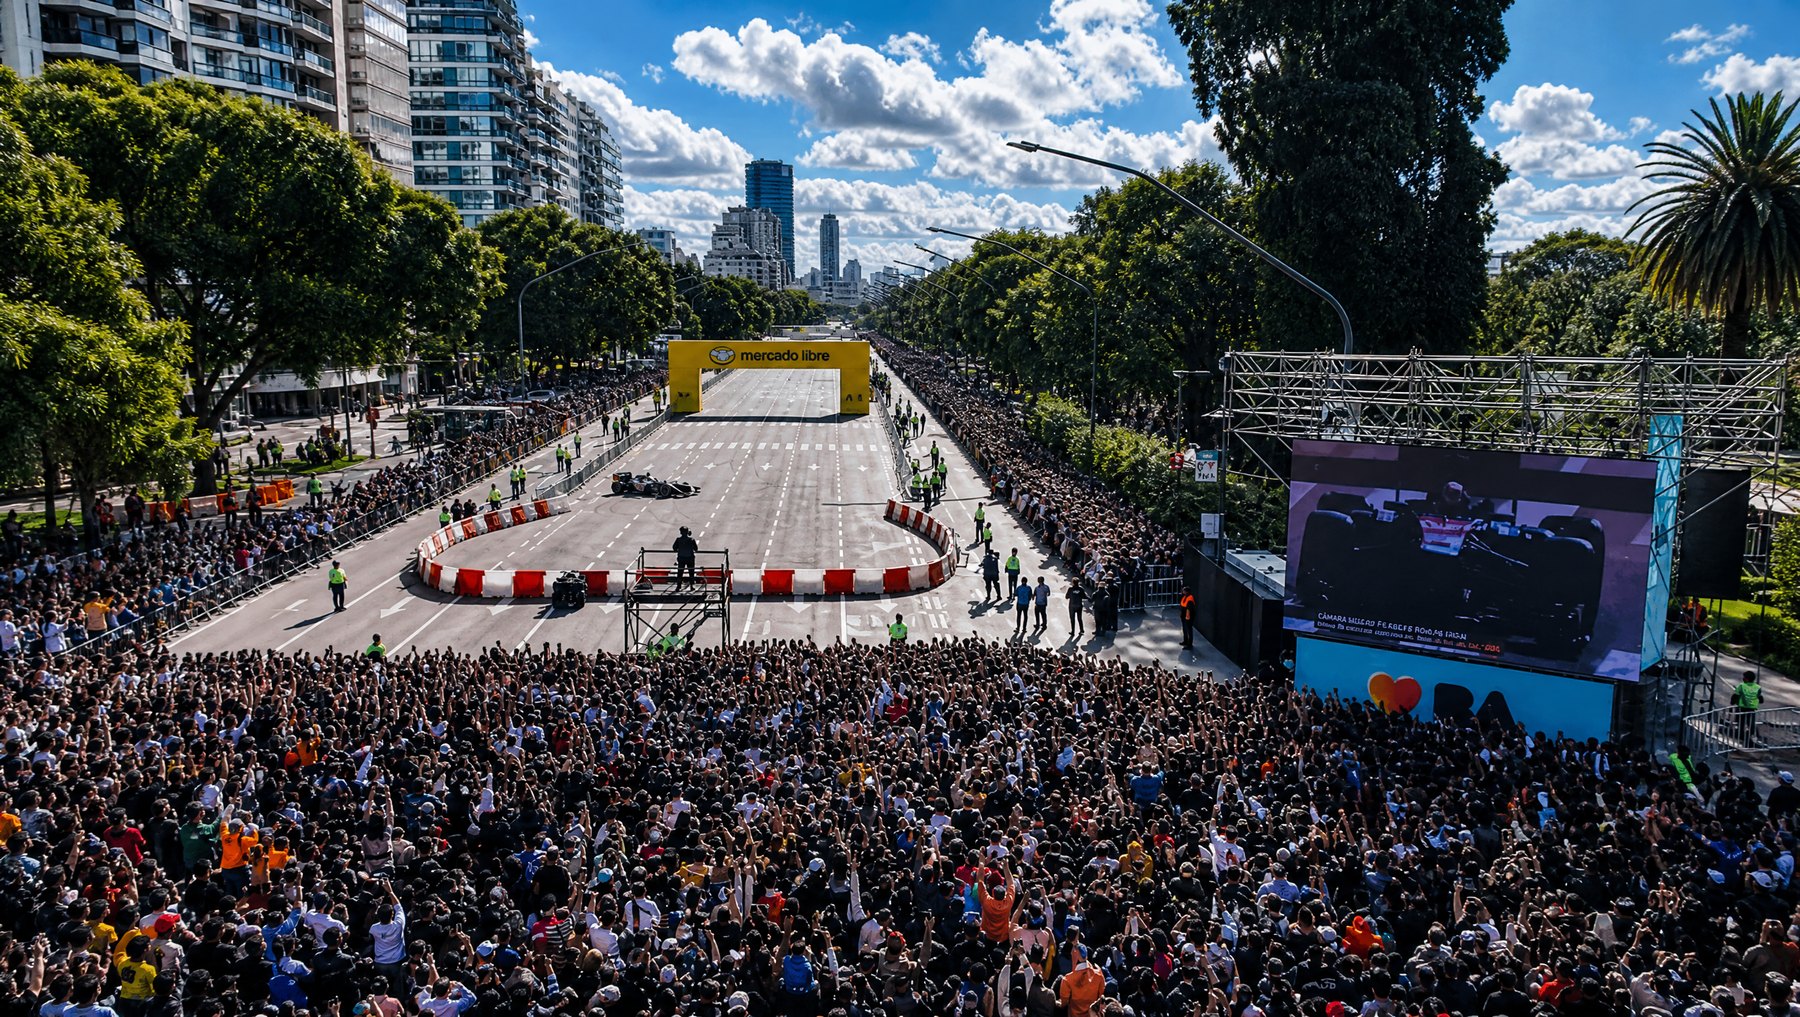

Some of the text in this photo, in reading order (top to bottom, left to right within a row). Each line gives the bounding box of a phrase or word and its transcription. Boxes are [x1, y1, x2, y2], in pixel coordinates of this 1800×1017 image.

[740, 350, 830, 361] mercado libre
[1434, 683, 1516, 727] BA
